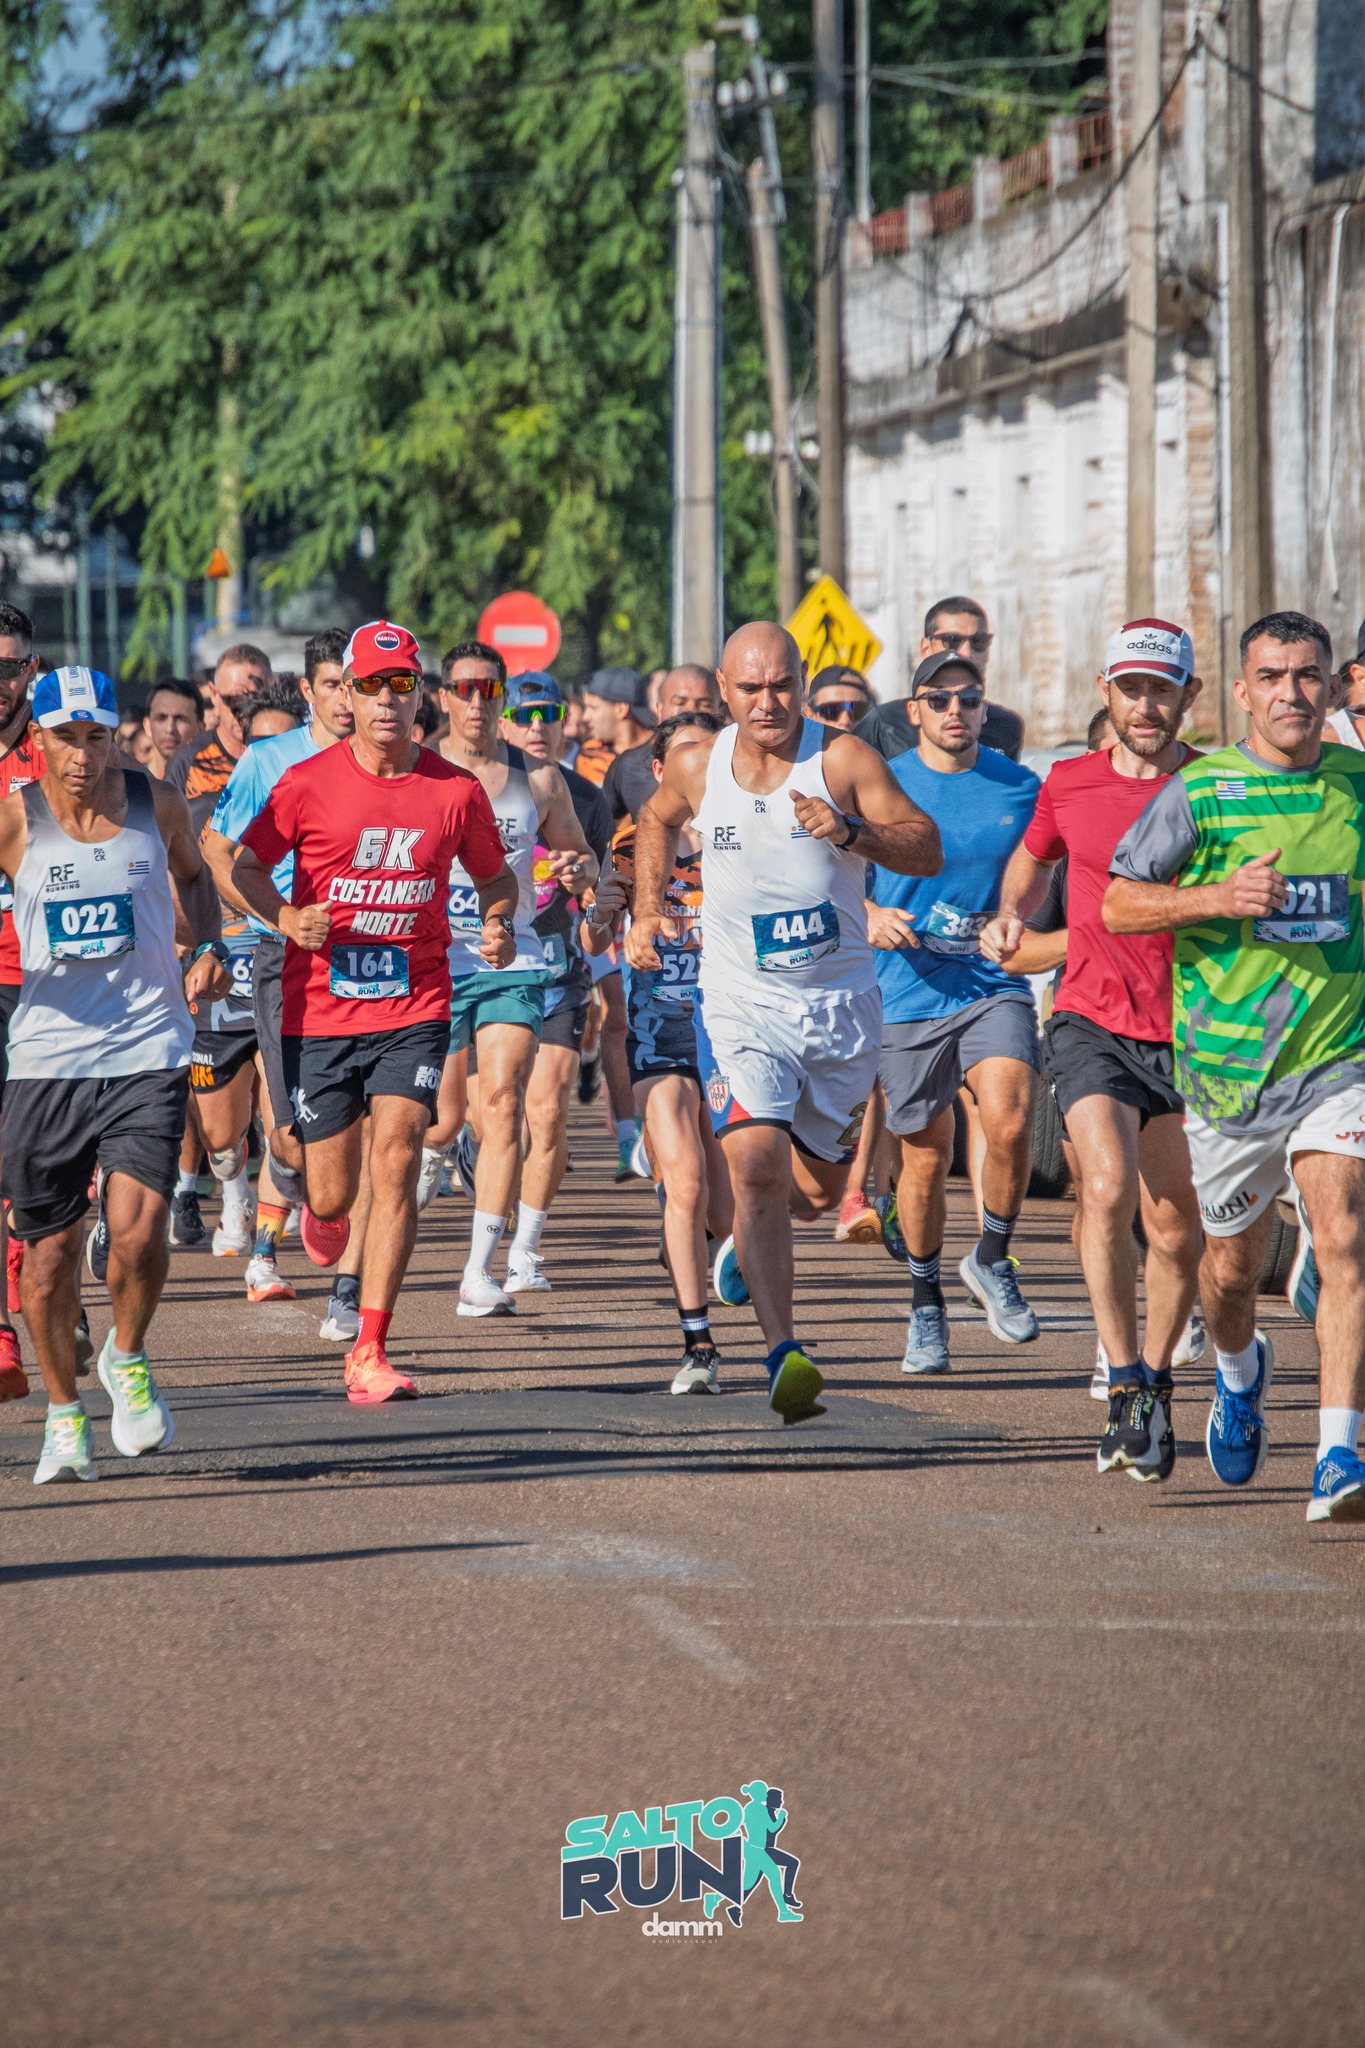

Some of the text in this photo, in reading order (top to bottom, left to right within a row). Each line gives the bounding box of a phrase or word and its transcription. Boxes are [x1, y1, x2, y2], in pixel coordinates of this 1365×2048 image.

[1126, 640, 1173, 655] adidas
[714, 826, 736, 842] RF
[352, 827, 426, 871] 6K
[49, 863, 75, 883] RF
[45, 883, 80, 893] RUNNING
[328, 877, 436, 905] COSTANERA
[61, 902, 119, 936] 022
[349, 911, 419, 936] NORTE
[772, 911, 826, 943] 444
[232, 958, 253, 982] 6
[347, 951, 394, 978] 164
[663, 952, 702, 982] 52
[790, 956, 810, 966] RUN
[414, 1070, 439, 1090] RU
